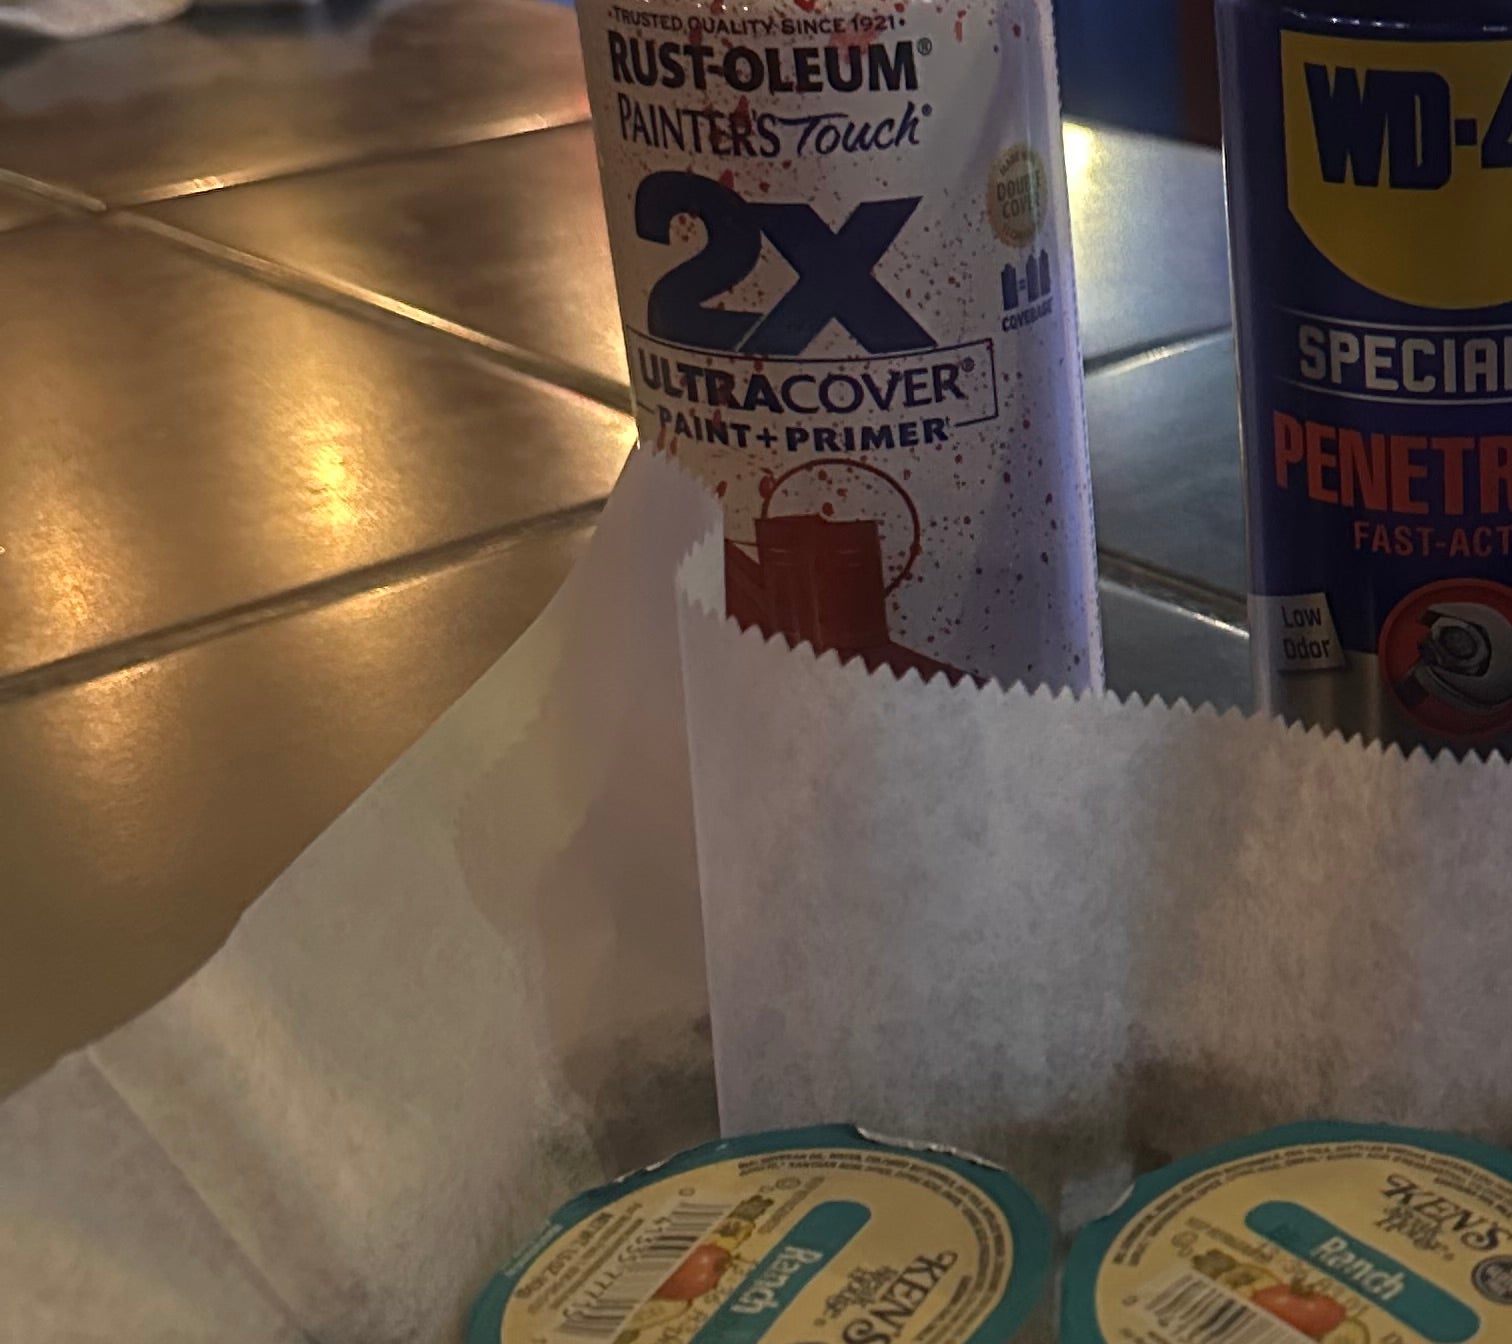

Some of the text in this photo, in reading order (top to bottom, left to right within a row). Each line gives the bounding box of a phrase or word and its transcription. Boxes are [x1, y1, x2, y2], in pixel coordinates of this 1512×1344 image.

[613, 6, 895, 35] TRUSTED QUALITY SINCE 1921
[608, 30, 918, 92] RUST-OLEUM
[618, 93, 919, 157] PAINTER'S Touch
[635, 171, 938, 355] 2X
[638, 349, 965, 414] ULTRACOVER
[1281, 606, 1322, 627] Low
[1283, 636, 1331, 660] Odor
[730, 1246, 823, 1314] Ranch
[1310, 1236, 1405, 1302] Ranch
